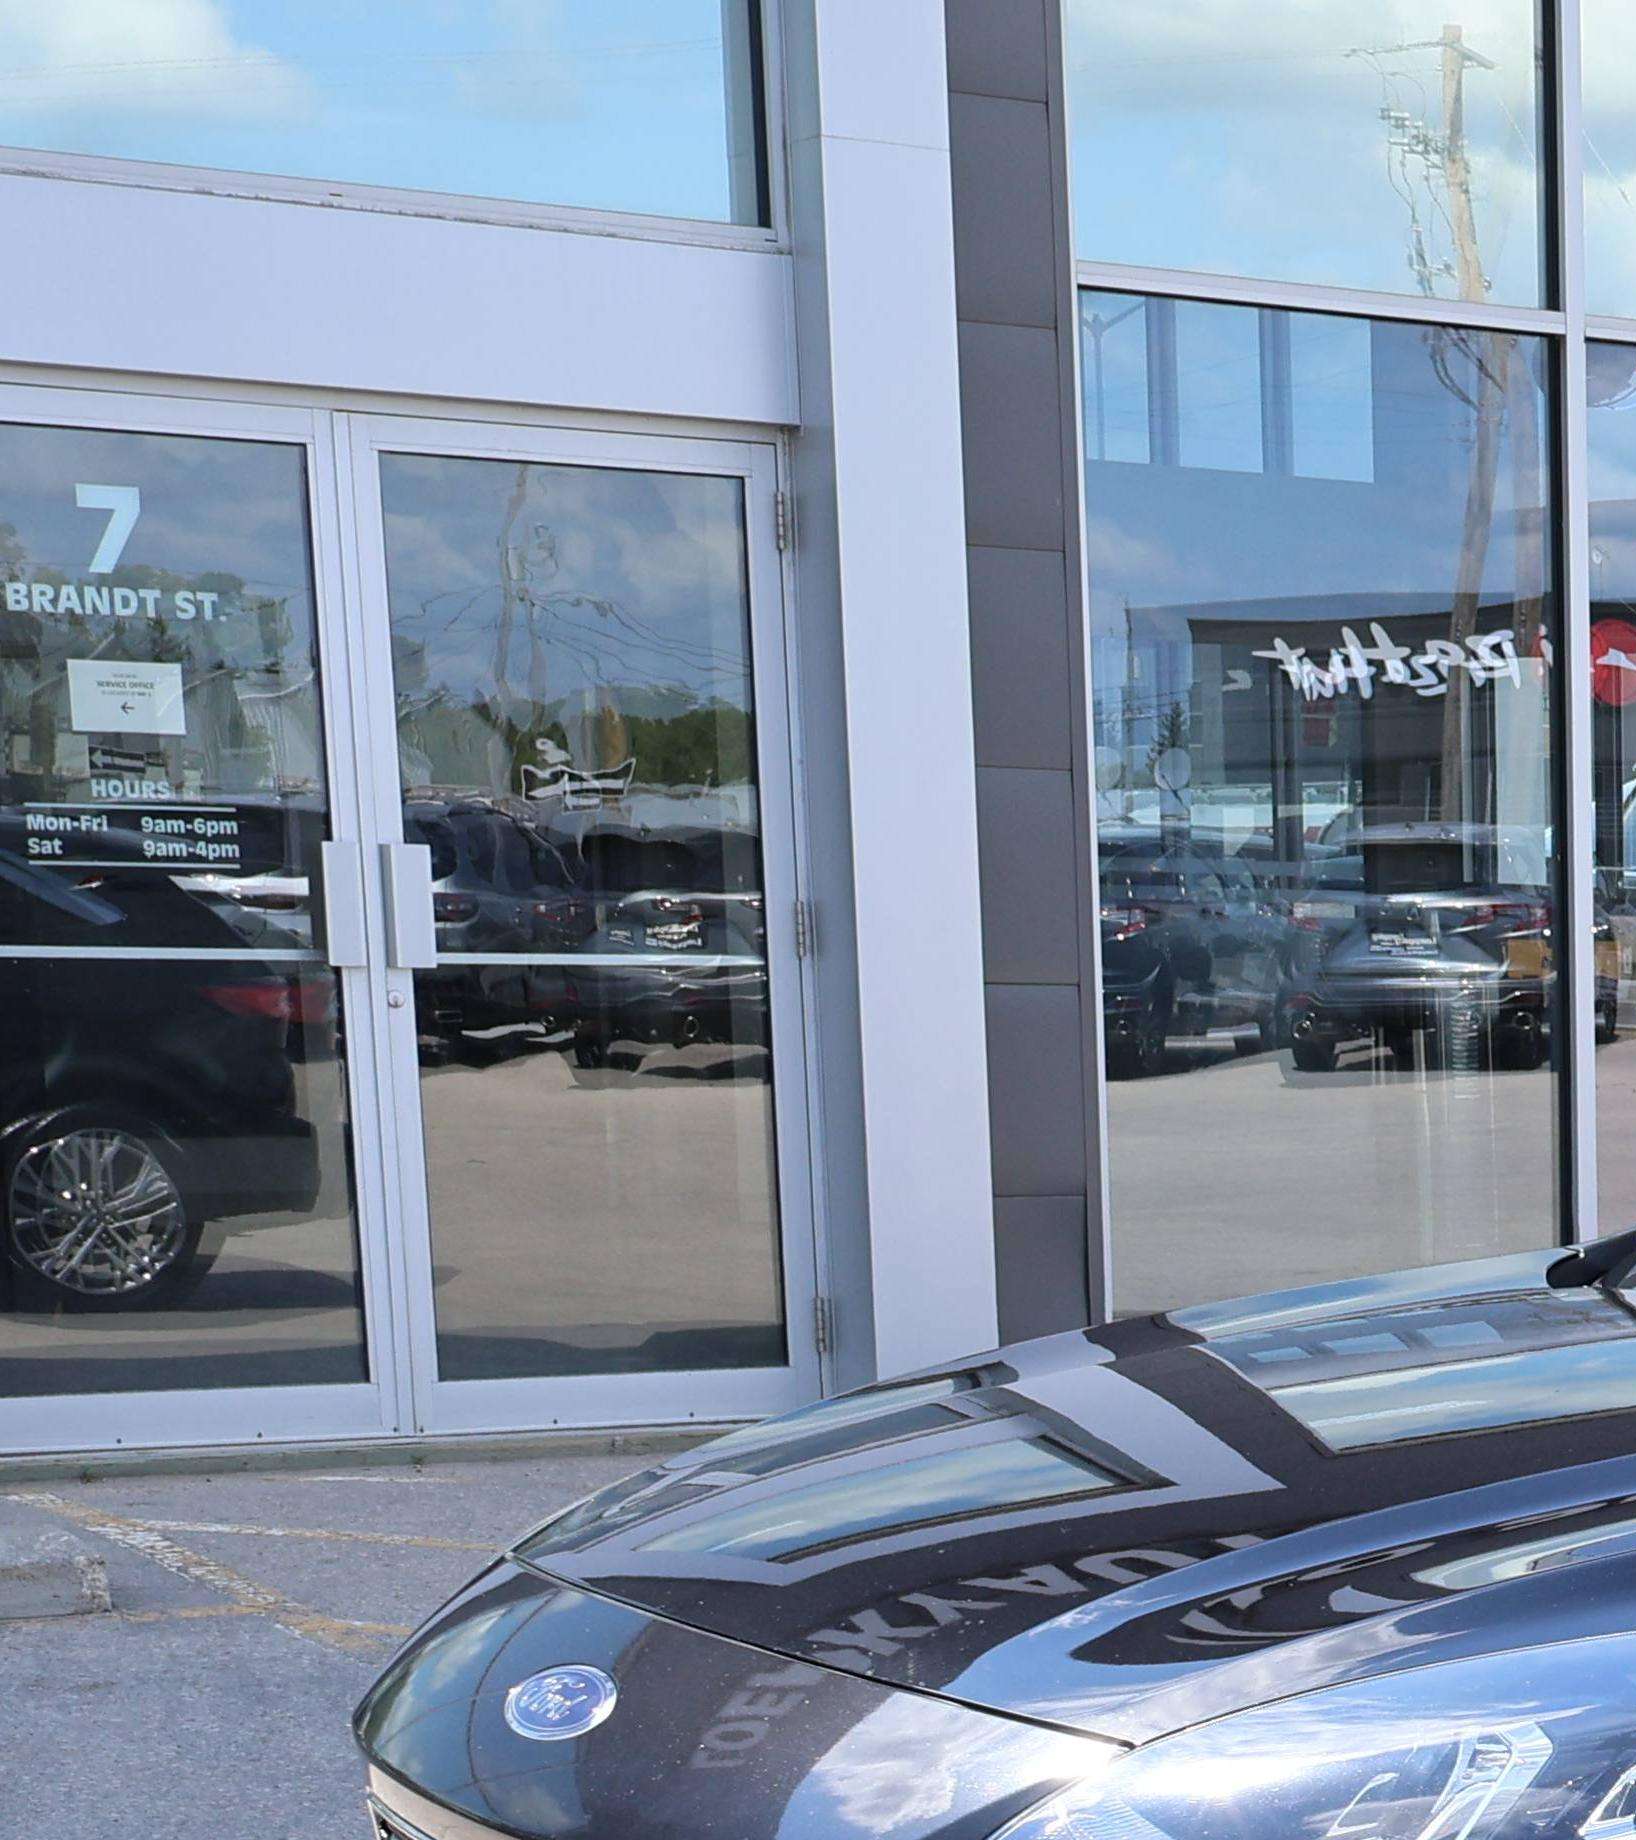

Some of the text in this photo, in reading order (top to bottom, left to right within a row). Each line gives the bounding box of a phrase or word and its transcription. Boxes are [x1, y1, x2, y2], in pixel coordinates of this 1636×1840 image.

[75, 483, 141, 574] 7
[4, 582, 227, 623] BRANDT ST.
[90, 778, 170, 799] HOURS
[25, 813, 239, 836] Mon-Fri 9am-6pm
[27, 837, 241, 860] Sat 9am-4pm
